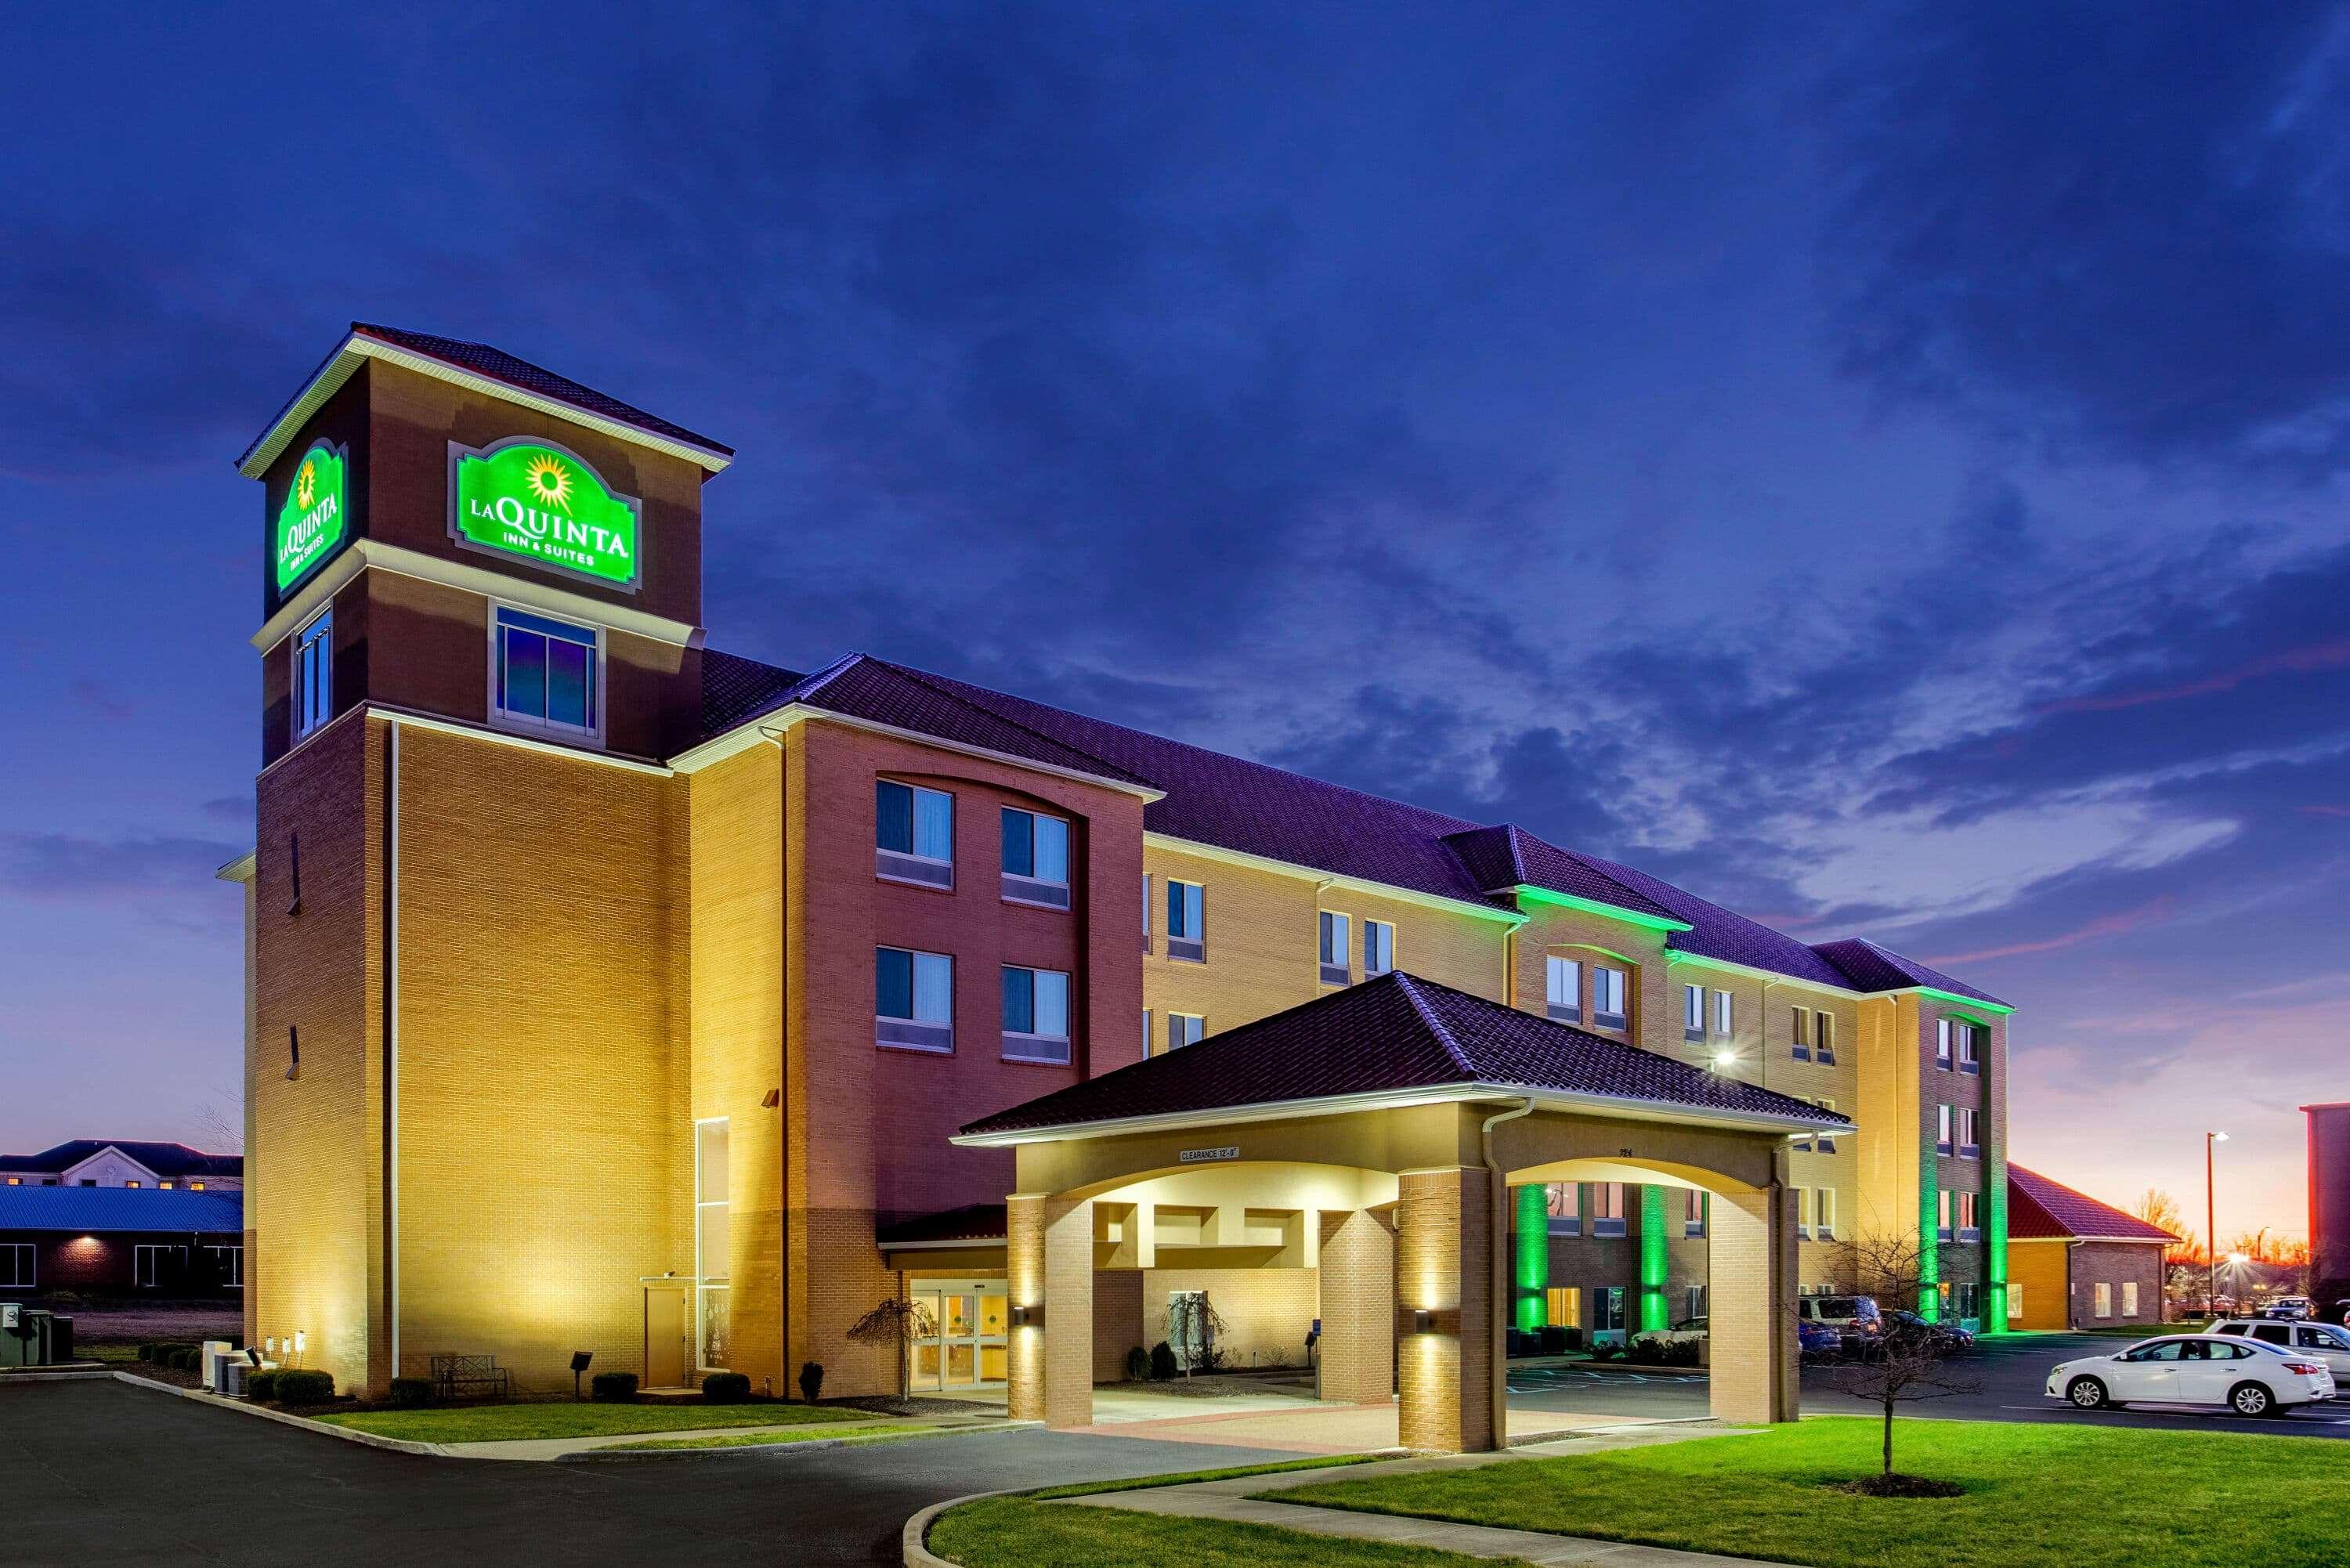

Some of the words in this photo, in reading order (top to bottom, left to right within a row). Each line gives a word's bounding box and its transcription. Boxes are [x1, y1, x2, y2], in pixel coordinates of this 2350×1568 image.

[280, 545, 288, 564] LA
[287, 493, 337, 553] QUINTA
[471, 498, 496, 520] LA
[496, 497, 629, 558] QUINTA
[303, 533, 324, 558] SUITES
[504, 531, 529, 548] INN
[532, 542, 540, 551] &
[544, 543, 595, 566] SUITES
[1181, 1150, 1217, 1160] CLEARANCE
